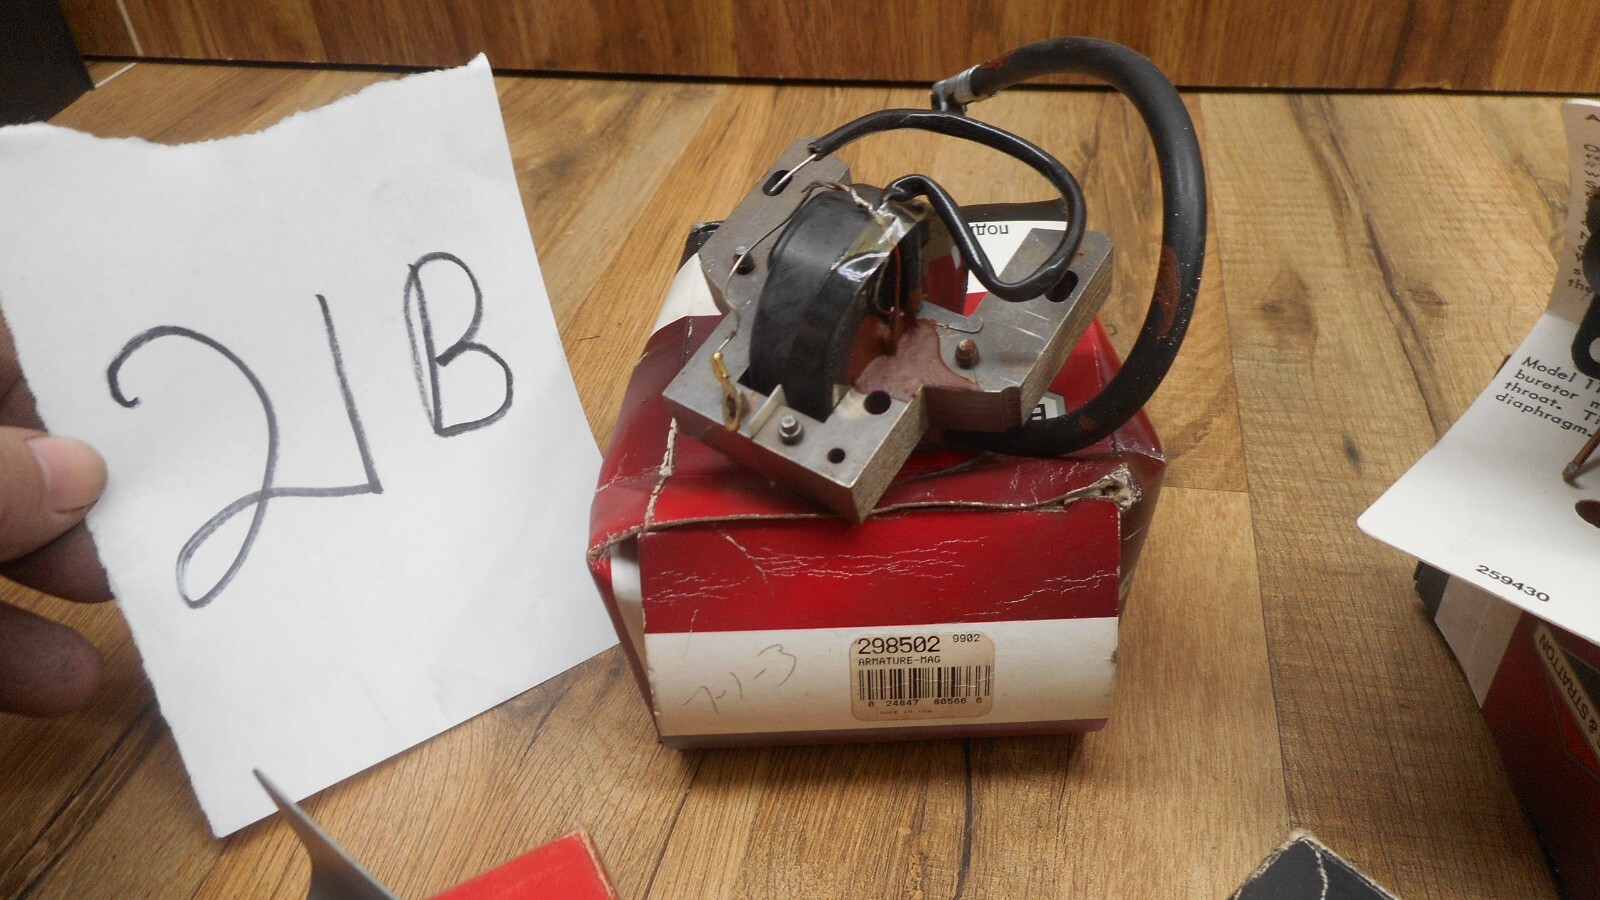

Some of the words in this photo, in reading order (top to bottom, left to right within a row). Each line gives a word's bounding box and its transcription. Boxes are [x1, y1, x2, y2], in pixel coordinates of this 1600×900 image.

[1521, 356, 1577, 382] Model
[1504, 382, 1562, 410] throat.
[1514, 369, 1579, 399] buretor
[1495, 393, 1593, 437] diaphragm.
[1476, 564, 1550, 602] 259430
[858, 635, 940, 654] 298502
[953, 634, 980, 643] 9902
[858, 656, 941, 665] ARMATURE-MAG
[1539, 633, 1589, 720] STRATTON
